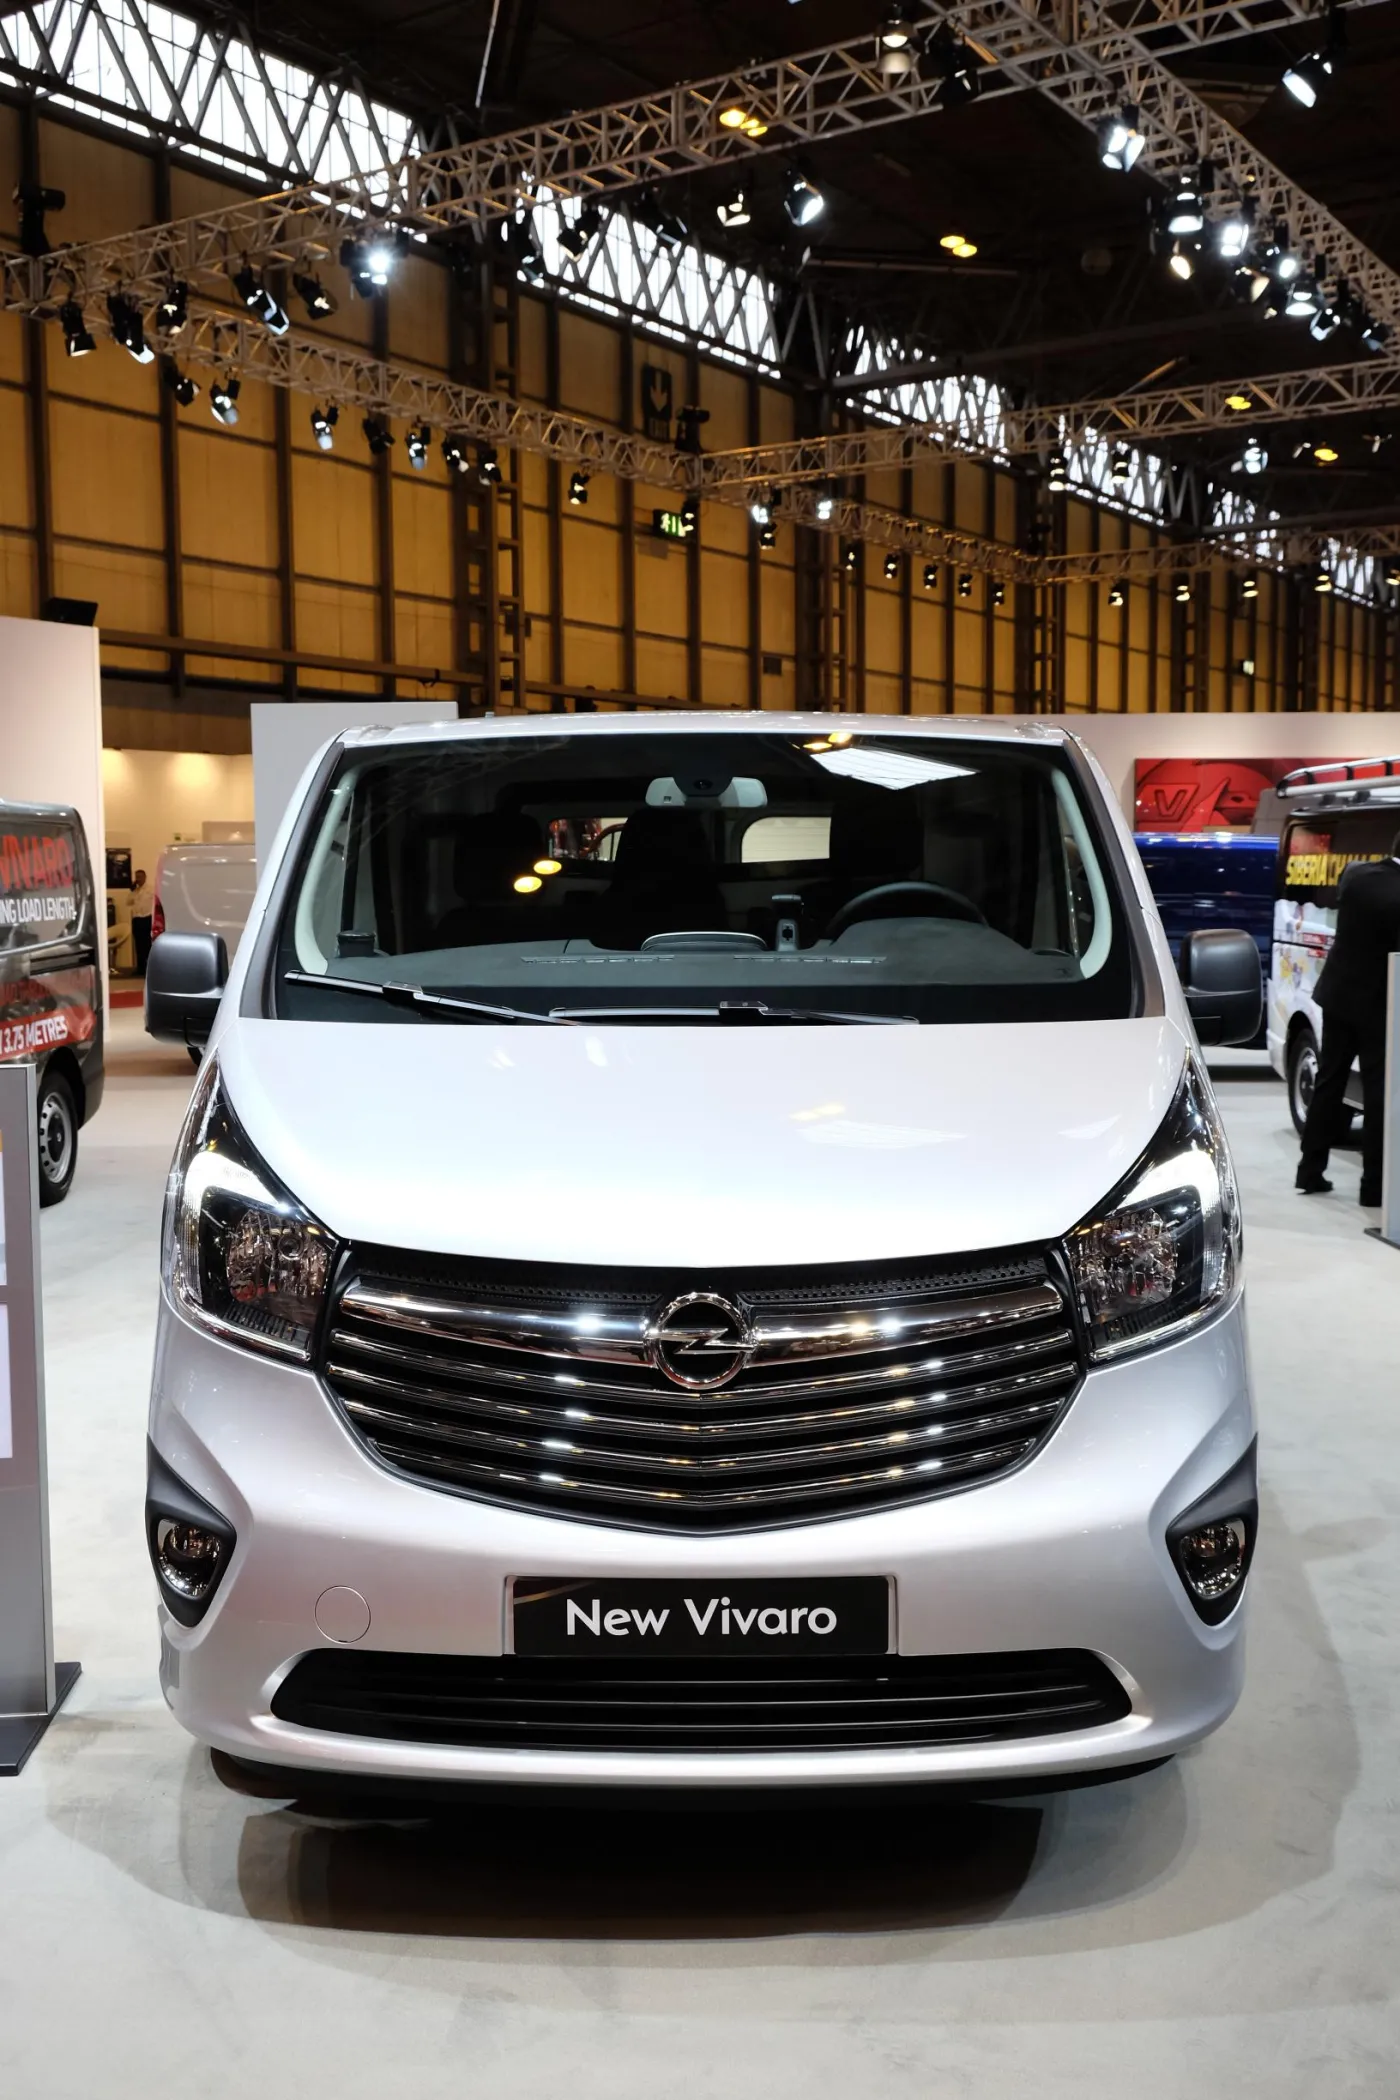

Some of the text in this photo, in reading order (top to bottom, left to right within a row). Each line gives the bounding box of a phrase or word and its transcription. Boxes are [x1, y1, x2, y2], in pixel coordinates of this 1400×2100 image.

[16, 898, 42, 922] LOAD
[26, 1015, 68, 1047] METRES
[566, 1596, 837, 1636] New Vivaro
